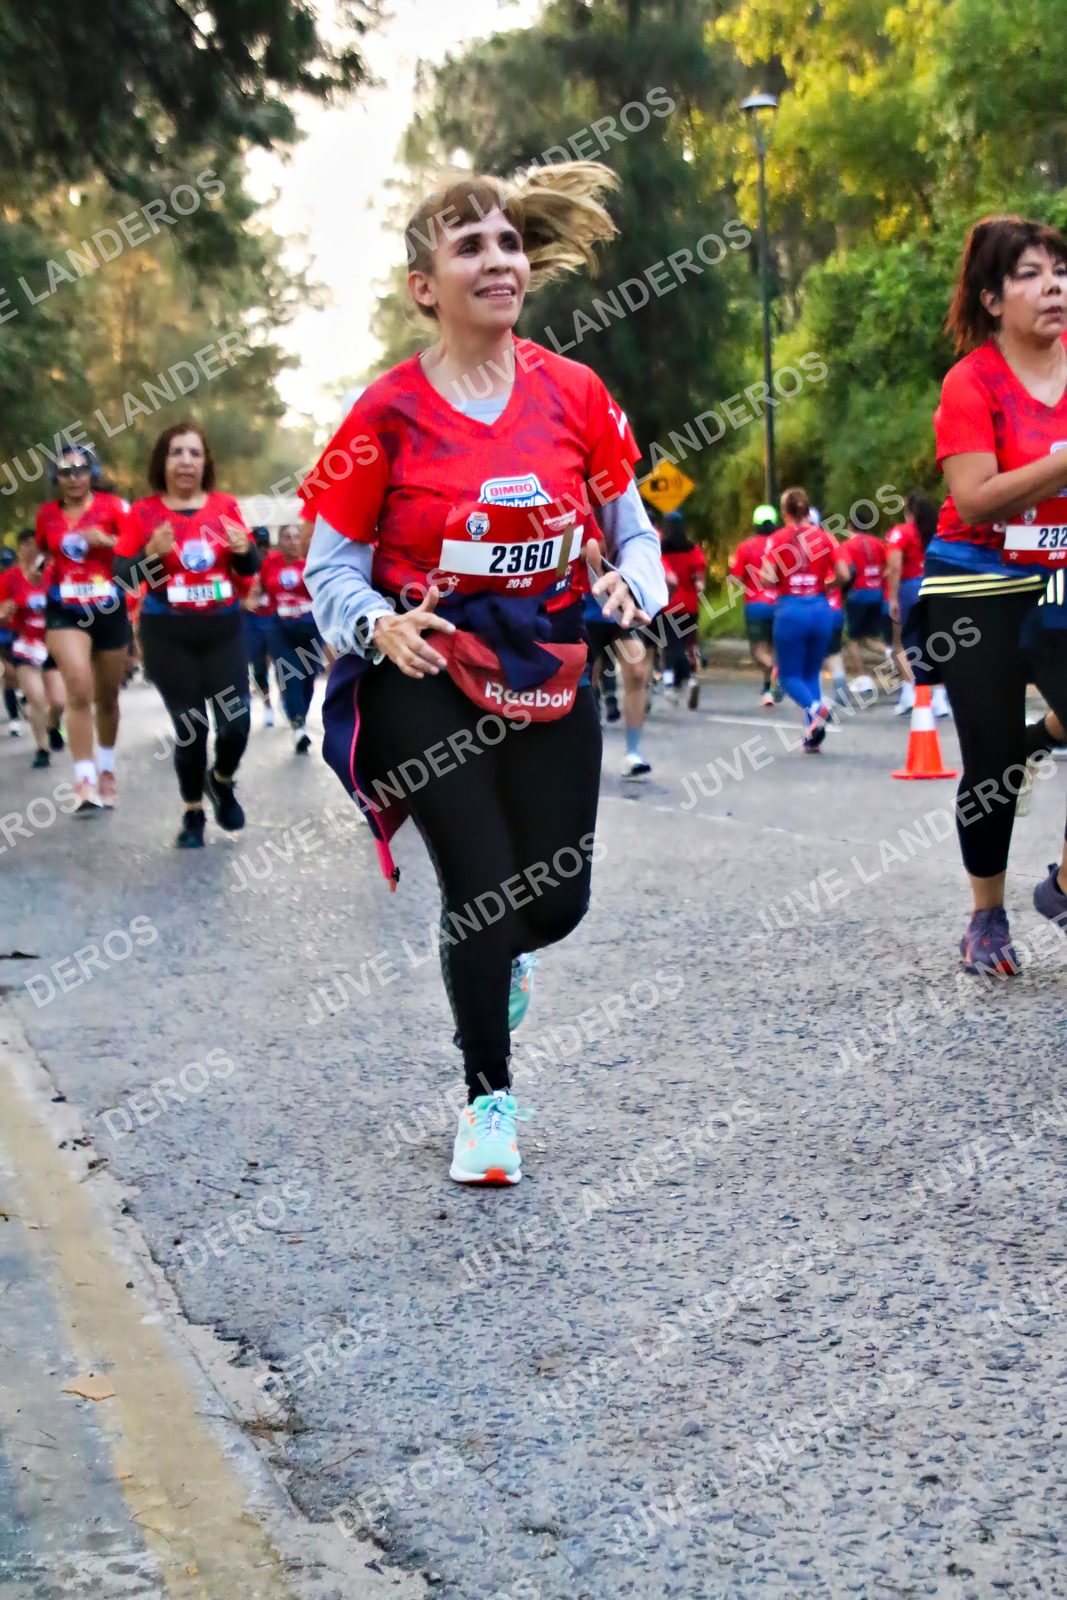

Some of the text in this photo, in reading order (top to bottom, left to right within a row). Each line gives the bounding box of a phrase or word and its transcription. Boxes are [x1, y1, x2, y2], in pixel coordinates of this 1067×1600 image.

[490, 483, 532, 496] BIMBO
[489, 540, 554, 573] 2360
[485, 681, 573, 707] Reebok
